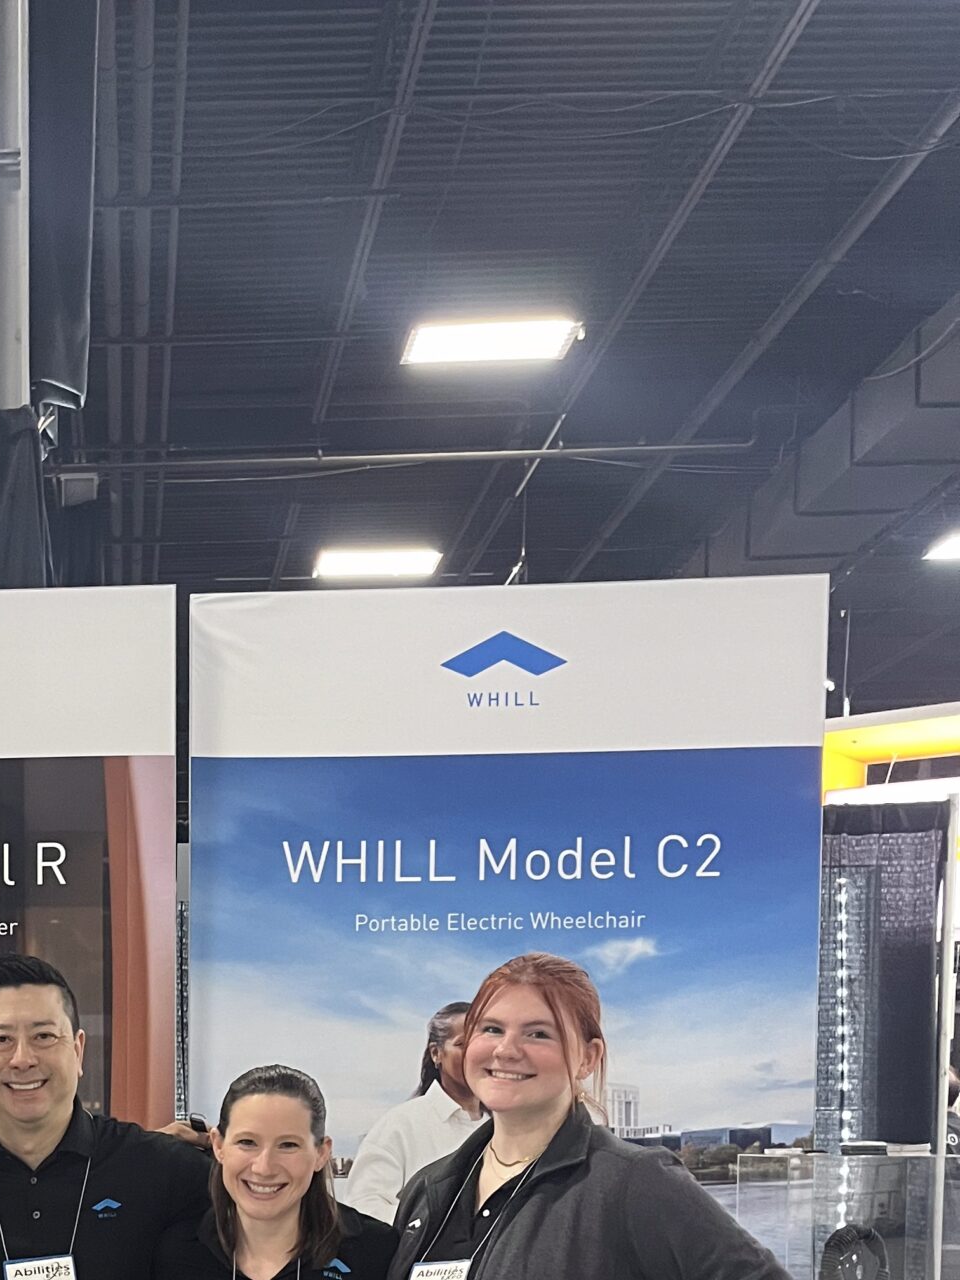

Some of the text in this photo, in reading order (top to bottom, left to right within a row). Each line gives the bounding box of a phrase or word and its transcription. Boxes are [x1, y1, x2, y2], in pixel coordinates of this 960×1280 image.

[467, 691, 540, 708] WHILL
[36, 842, 68, 886] R
[282, 833, 722, 883] WHILL Model C2
[355, 910, 646, 932] Portable Electric Wheelchair
[13, 1264, 71, 1278] Abilities
[416, 1267, 464, 1278] Abilities
